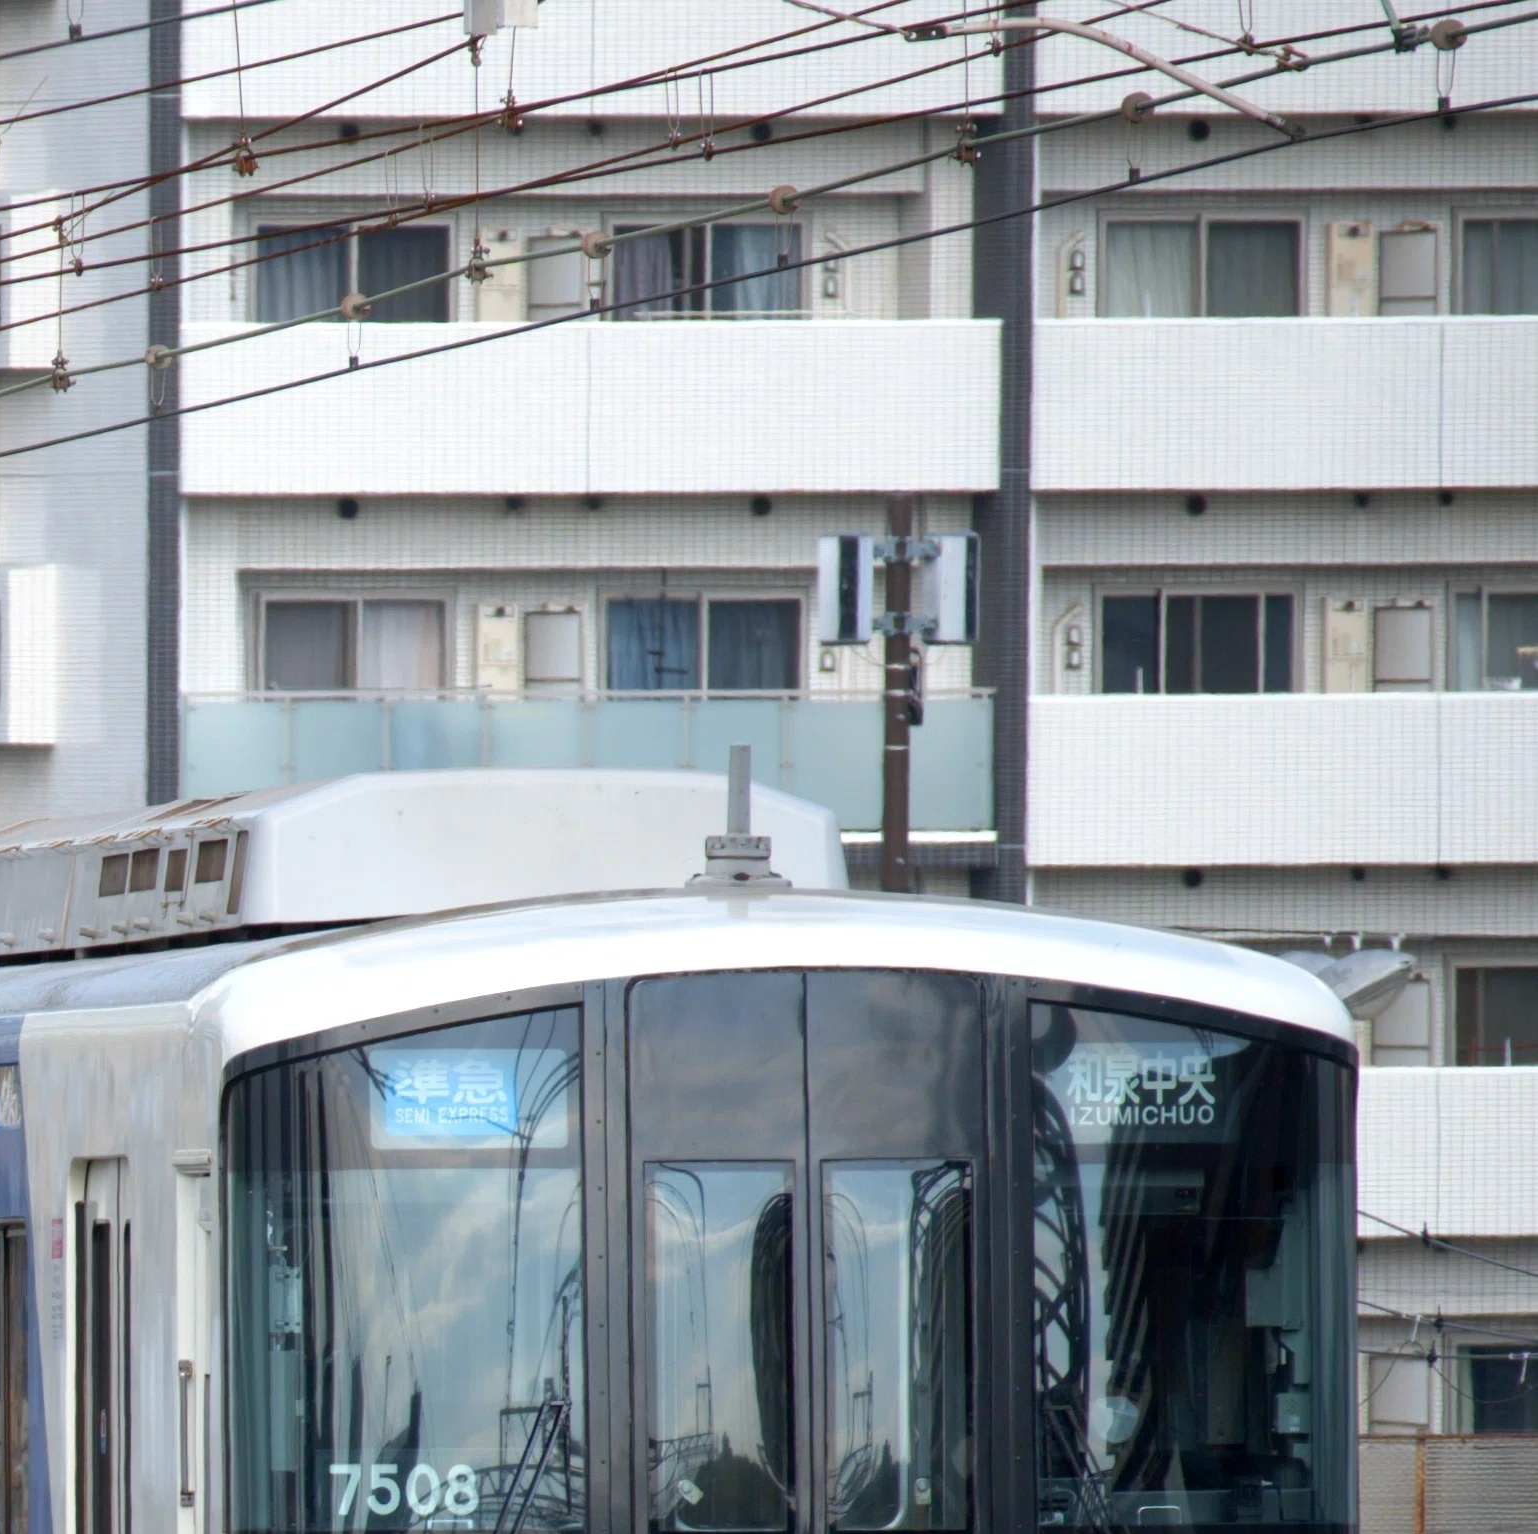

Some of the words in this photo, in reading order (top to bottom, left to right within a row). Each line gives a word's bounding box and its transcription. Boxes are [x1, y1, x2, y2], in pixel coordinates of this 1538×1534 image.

[394, 1058, 508, 1104] 準急
[1067, 1049, 1216, 1105] 和泉中央
[394, 1106, 430, 1124] SEMI
[437, 1105, 509, 1124] EXPRESS
[1071, 1104, 1215, 1126] IZUMICHUO
[329, 1463, 480, 1516] 7508
